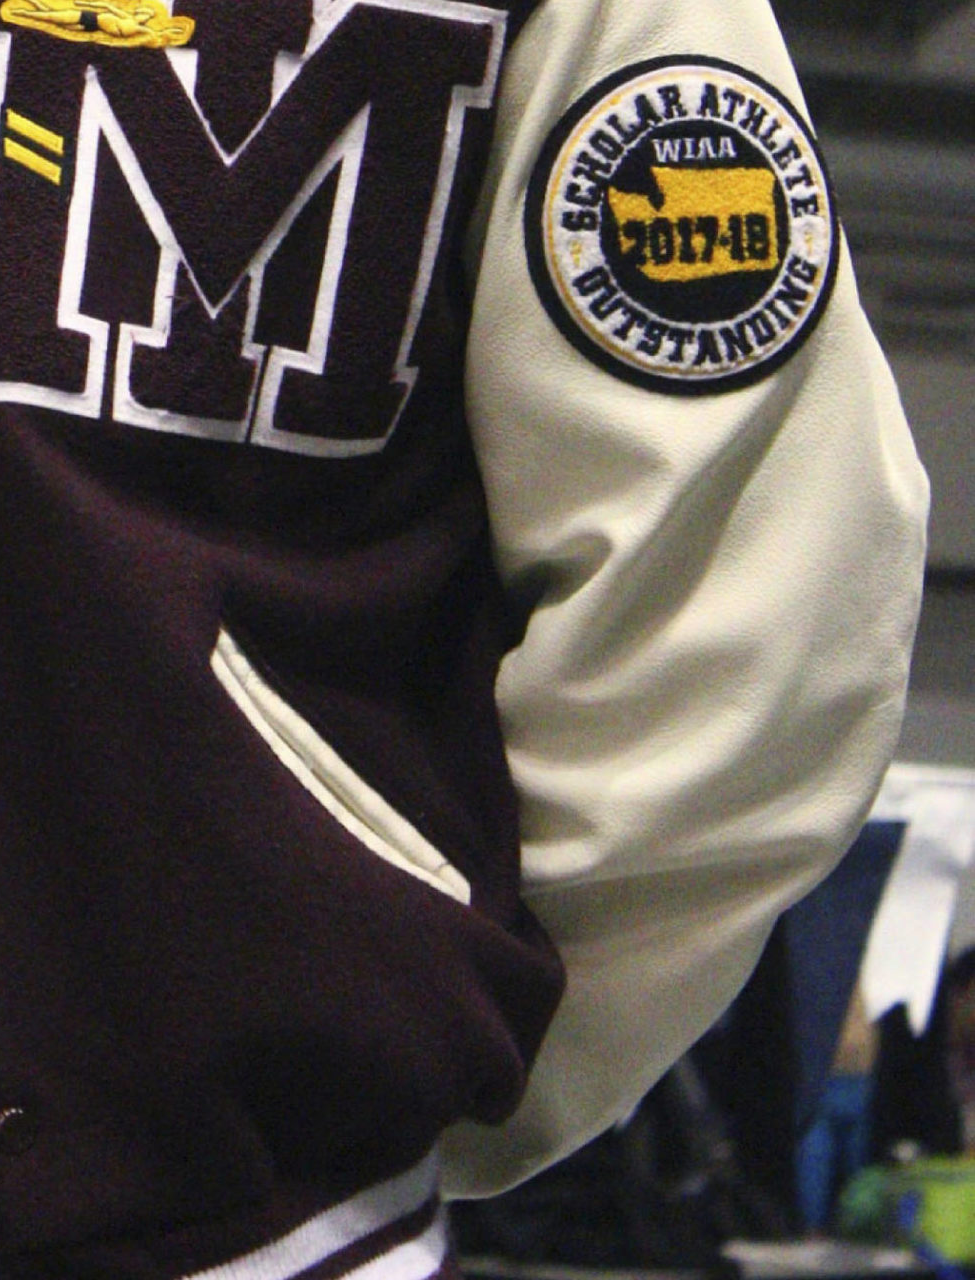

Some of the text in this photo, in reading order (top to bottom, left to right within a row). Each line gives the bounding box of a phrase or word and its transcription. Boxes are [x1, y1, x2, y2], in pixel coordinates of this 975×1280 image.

[562, 83, 820, 232] SCHOLAR ATHLETE
[652, 137, 737, 162] WIAA
[621, 213, 770, 265] 2017-18
[572, 255, 818, 366] OUTSTANDING
